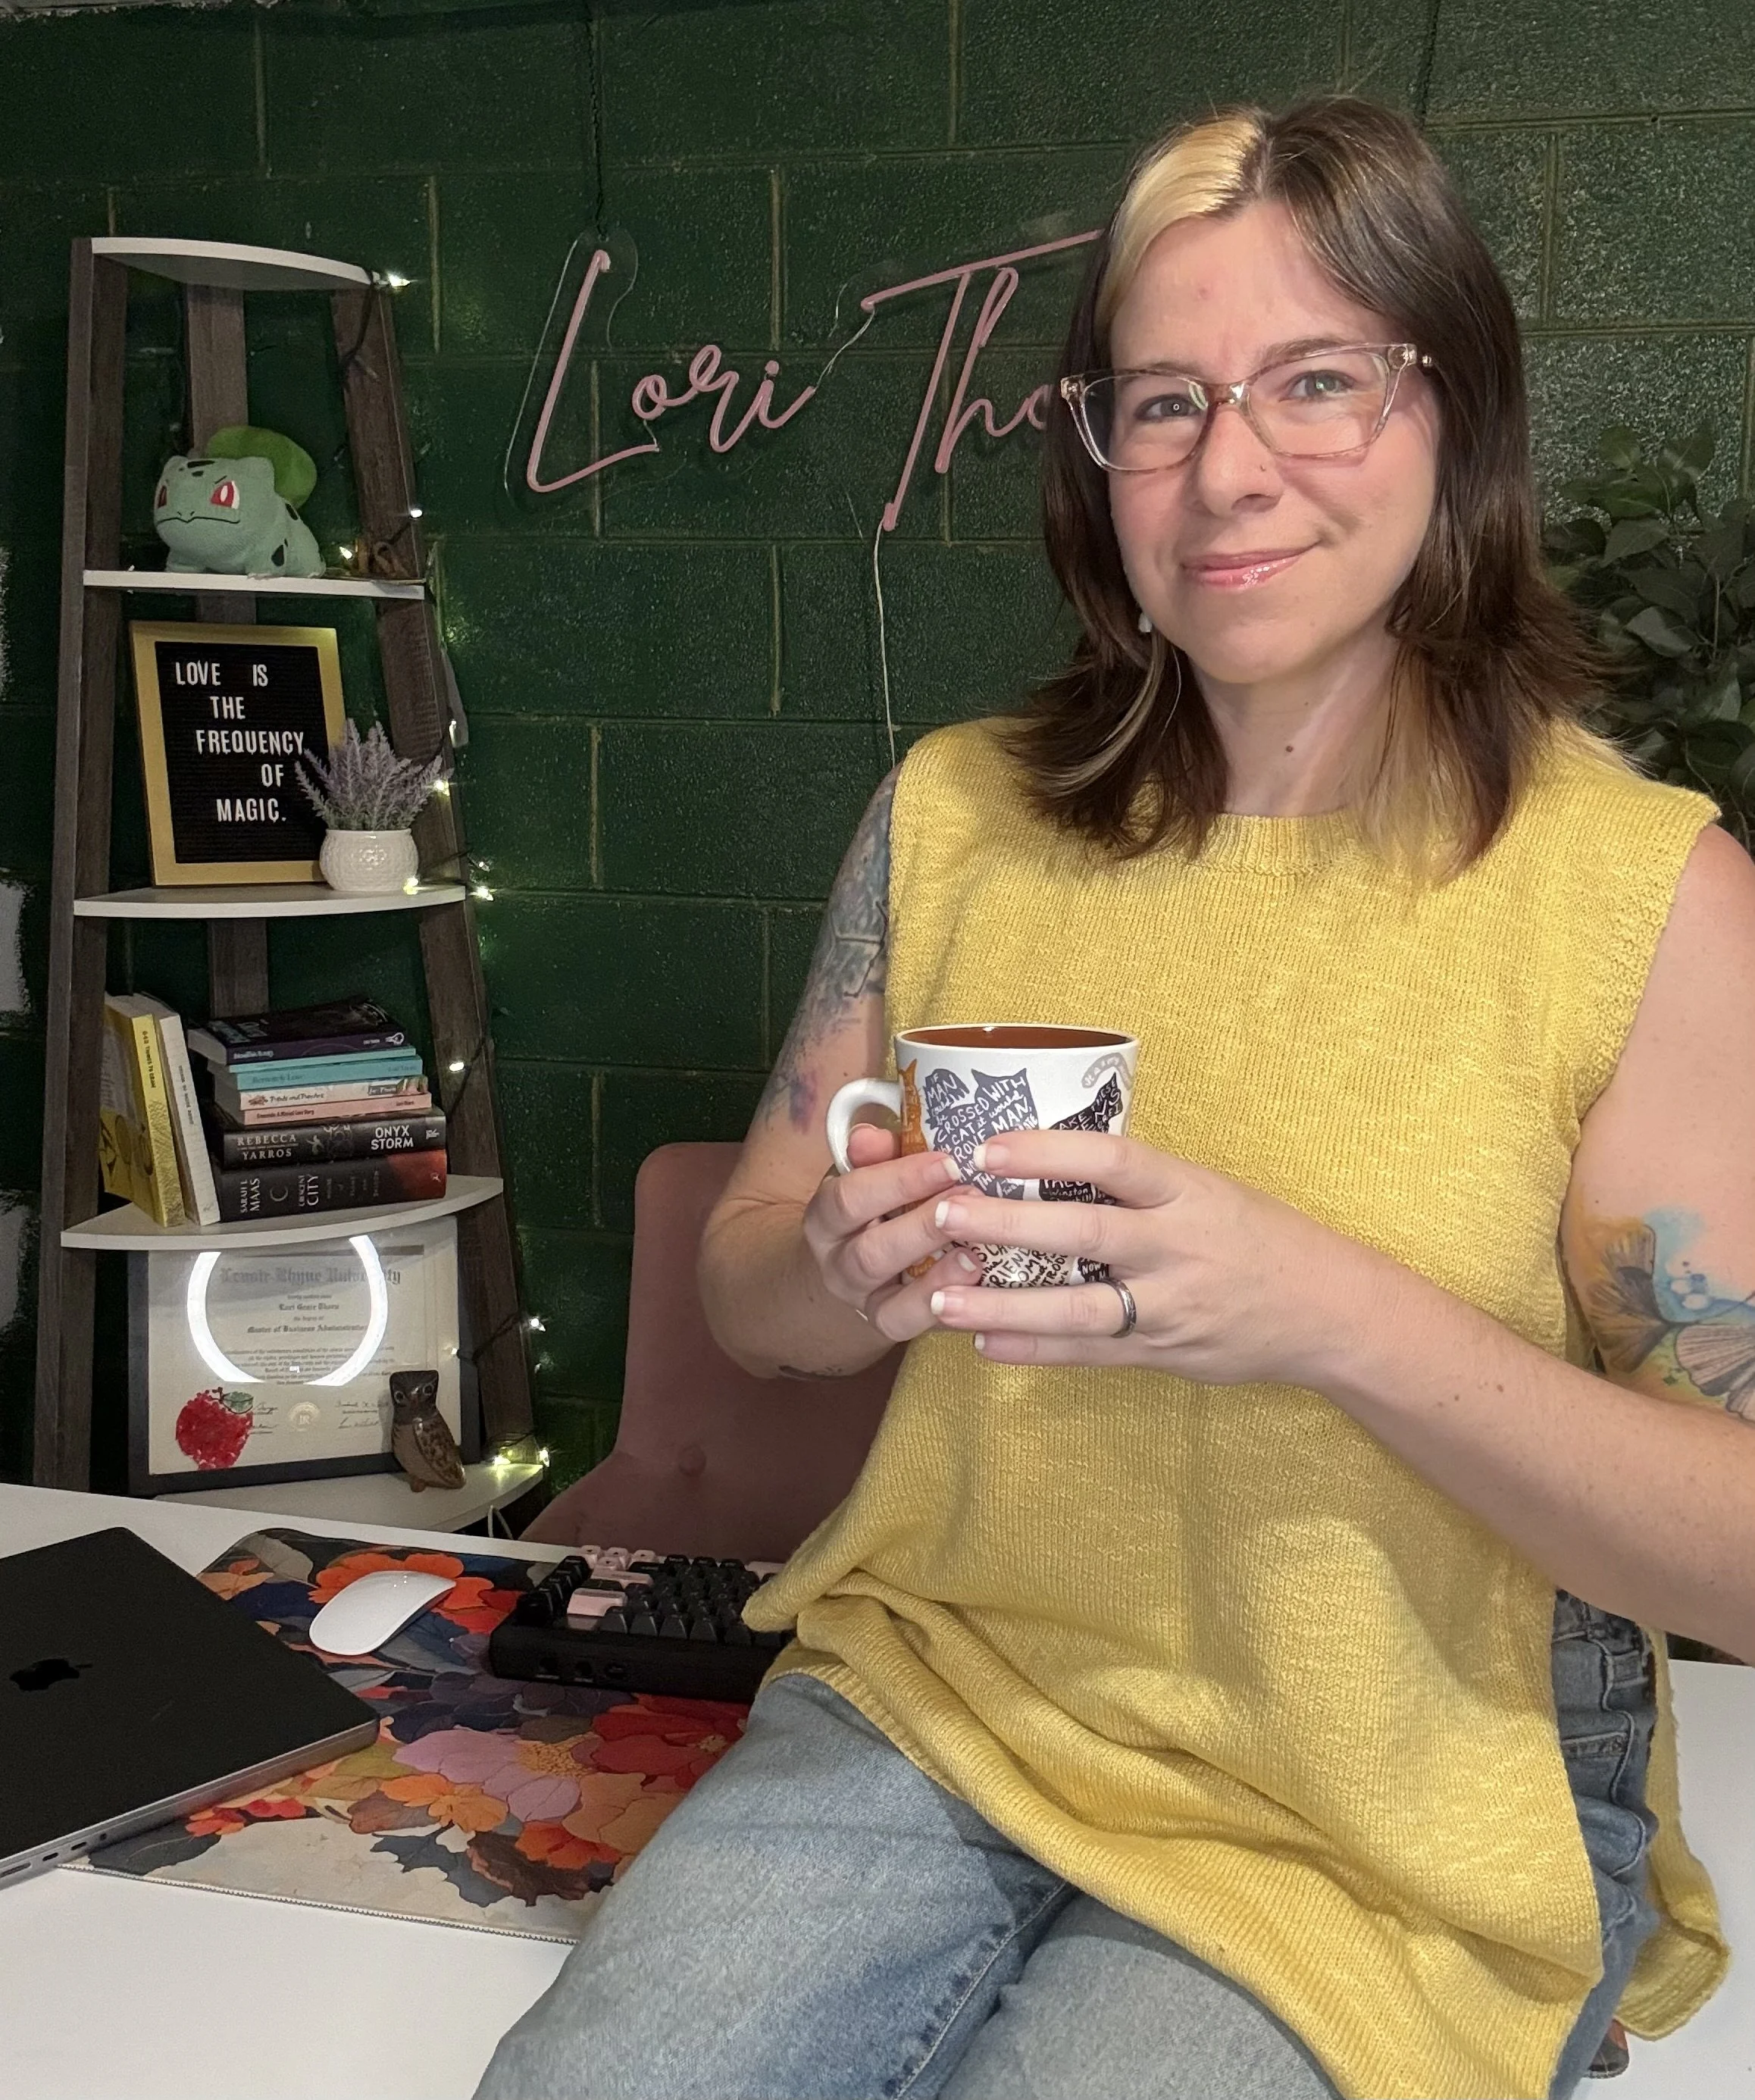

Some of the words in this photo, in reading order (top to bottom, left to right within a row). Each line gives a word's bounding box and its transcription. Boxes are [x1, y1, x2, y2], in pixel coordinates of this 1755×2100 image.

[527, 249, 817, 493] Lori
[861, 229, 1104, 530] Tho
[175, 660, 221, 686] LOVE
[252, 664, 268, 687] IS
[210, 696, 246, 719] THE
[196, 730, 304, 756] FREQUENCY
[261, 764, 284, 787] OF
[216, 798, 286, 823] MAGIC.
[926, 1074, 958, 1107] MAN
[931, 1072, 939, 1084] IF
[936, 1115, 948, 1126] be
[937, 1097, 990, 1142] CROSSED
[982, 1076, 1027, 1102] WITH
[952, 1122, 976, 1145] CAT
[978, 1116, 987, 1128] it
[988, 1090, 1025, 1118] would
[1059, 1111, 1086, 1130] AKE
[237, 1134, 296, 1147] REBECCA
[375, 1125, 410, 1138] ONYX
[953, 1128, 987, 1163] ROVE
[991, 1097, 1032, 1135] MAN,
[242, 1148, 292, 1161] YARROS
[371, 1137, 415, 1150] STORM
[306, 1174, 319, 1206] CITY
[972, 1171, 995, 1191] TH
[240, 1188, 249, 1213] SARAH
[250, 1178, 261, 1212] MAAS
[989, 1249, 1031, 1288] RIEN
